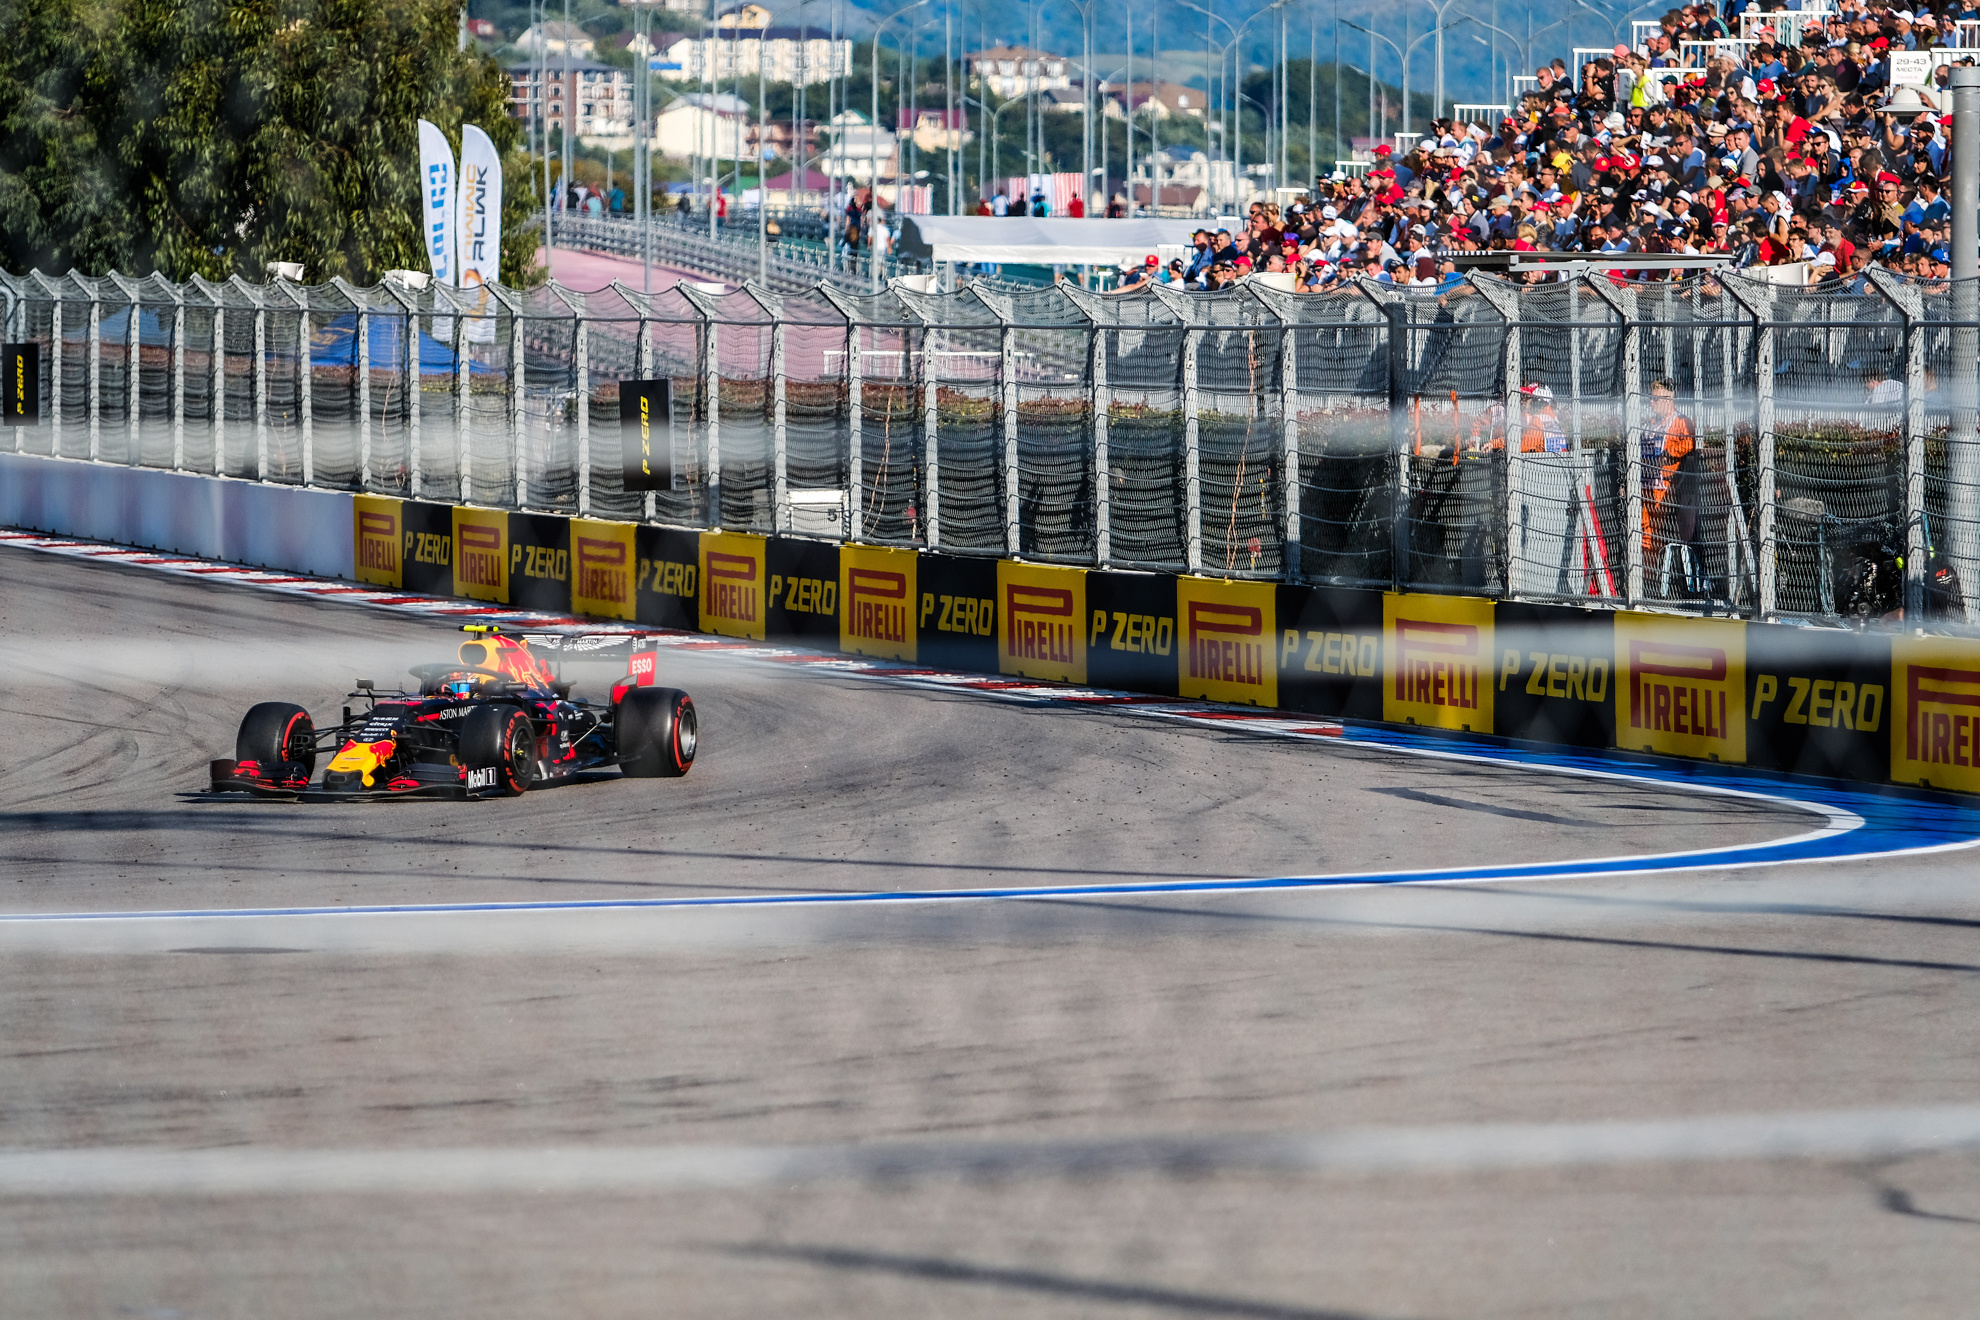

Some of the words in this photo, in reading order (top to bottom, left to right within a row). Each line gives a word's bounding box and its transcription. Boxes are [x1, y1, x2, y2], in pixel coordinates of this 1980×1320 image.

[16, 354, 24, 401] ZERO
[17, 402, 24, 415] P
[640, 395, 650, 457] ZERO
[642, 458, 651, 475] P
[359, 511, 396, 573] PIRELLI
[404, 531, 413, 560] P
[415, 533, 451, 566] ZERO
[458, 523, 501, 587] PIRELLI
[511, 544, 522, 574] P
[524, 546, 568, 581] ZERO
[577, 536, 628, 603] PIRELLI
[637, 558, 650, 590] P
[652, 560, 696, 598] ZERO
[706, 551, 756, 622] PIRELLI
[768, 574, 782, 608] P
[785, 577, 837, 615] ZERO
[848, 567, 906, 643] PIRELLI
[920, 593, 935, 628] P
[938, 595, 994, 636] ZERO
[1007, 583, 1074, 663] PIRELLI
[1090, 609, 1107, 647] P
[1110, 612, 1174, 656] ZERO
[1188, 600, 1263, 685] PIRELLI
[632, 658, 652, 674] ESSO
[1281, 629, 1299, 669] P
[1304, 630, 1378, 677] ZERO
[1395, 617, 1478, 710] PIRELLI
[1499, 649, 1521, 692] P
[1525, 652, 1609, 703] ZERO
[1629, 639, 1727, 740] PIRELLI
[1751, 674, 1778, 720] P
[1783, 677, 1884, 732] ZERO
[439, 708, 458, 720] ASTON
[1906, 664, 1980, 768] PIREL
[504, 718, 515, 762] ZERO
[468, 768, 486, 789] Mobil
